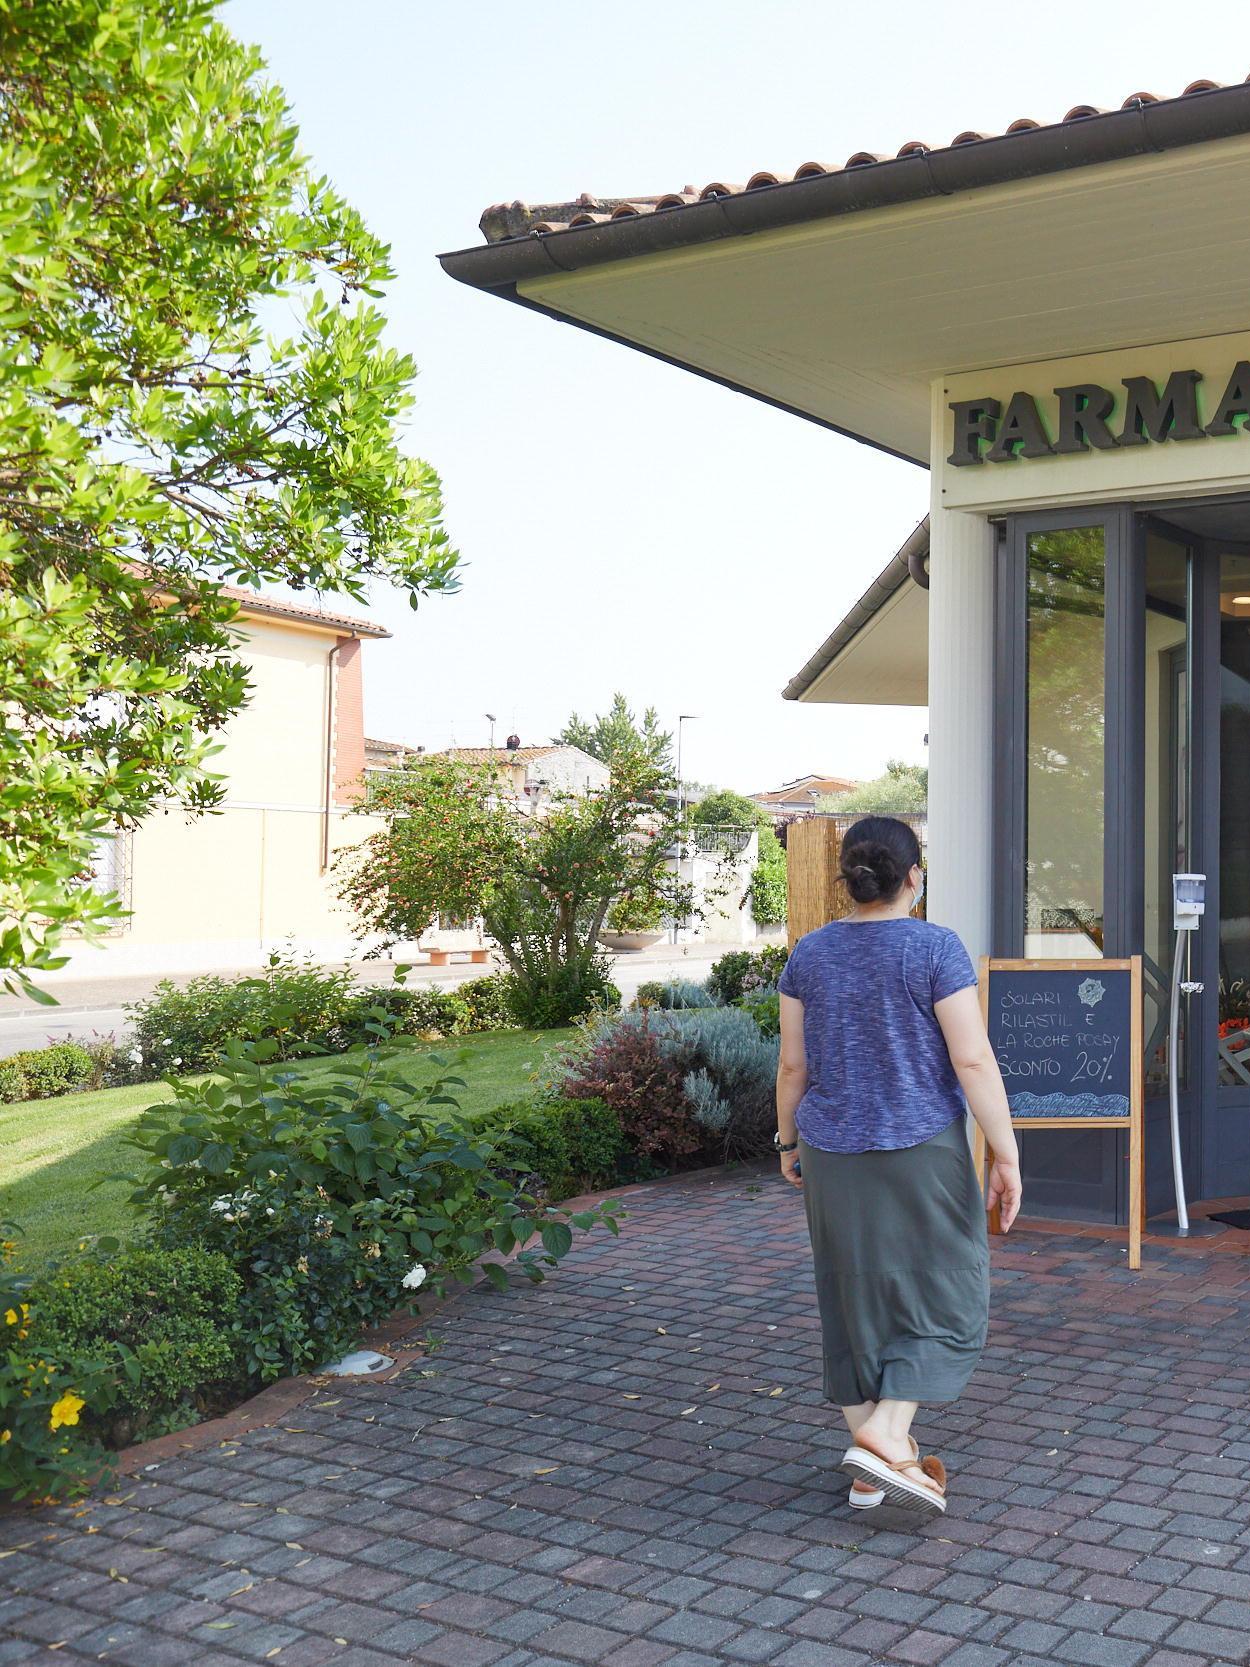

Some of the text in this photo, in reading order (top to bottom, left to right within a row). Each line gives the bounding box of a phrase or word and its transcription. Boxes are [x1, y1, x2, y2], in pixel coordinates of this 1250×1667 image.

[1000, 990, 1060, 1008] SOLARI
[1001, 1012, 1096, 1028] RILASTIL E
[997, 1034, 1017, 1049] LA
[1023, 1033, 1070, 1048] ROCHE
[997, 1051, 1113, 1083] SCONTO 20%
